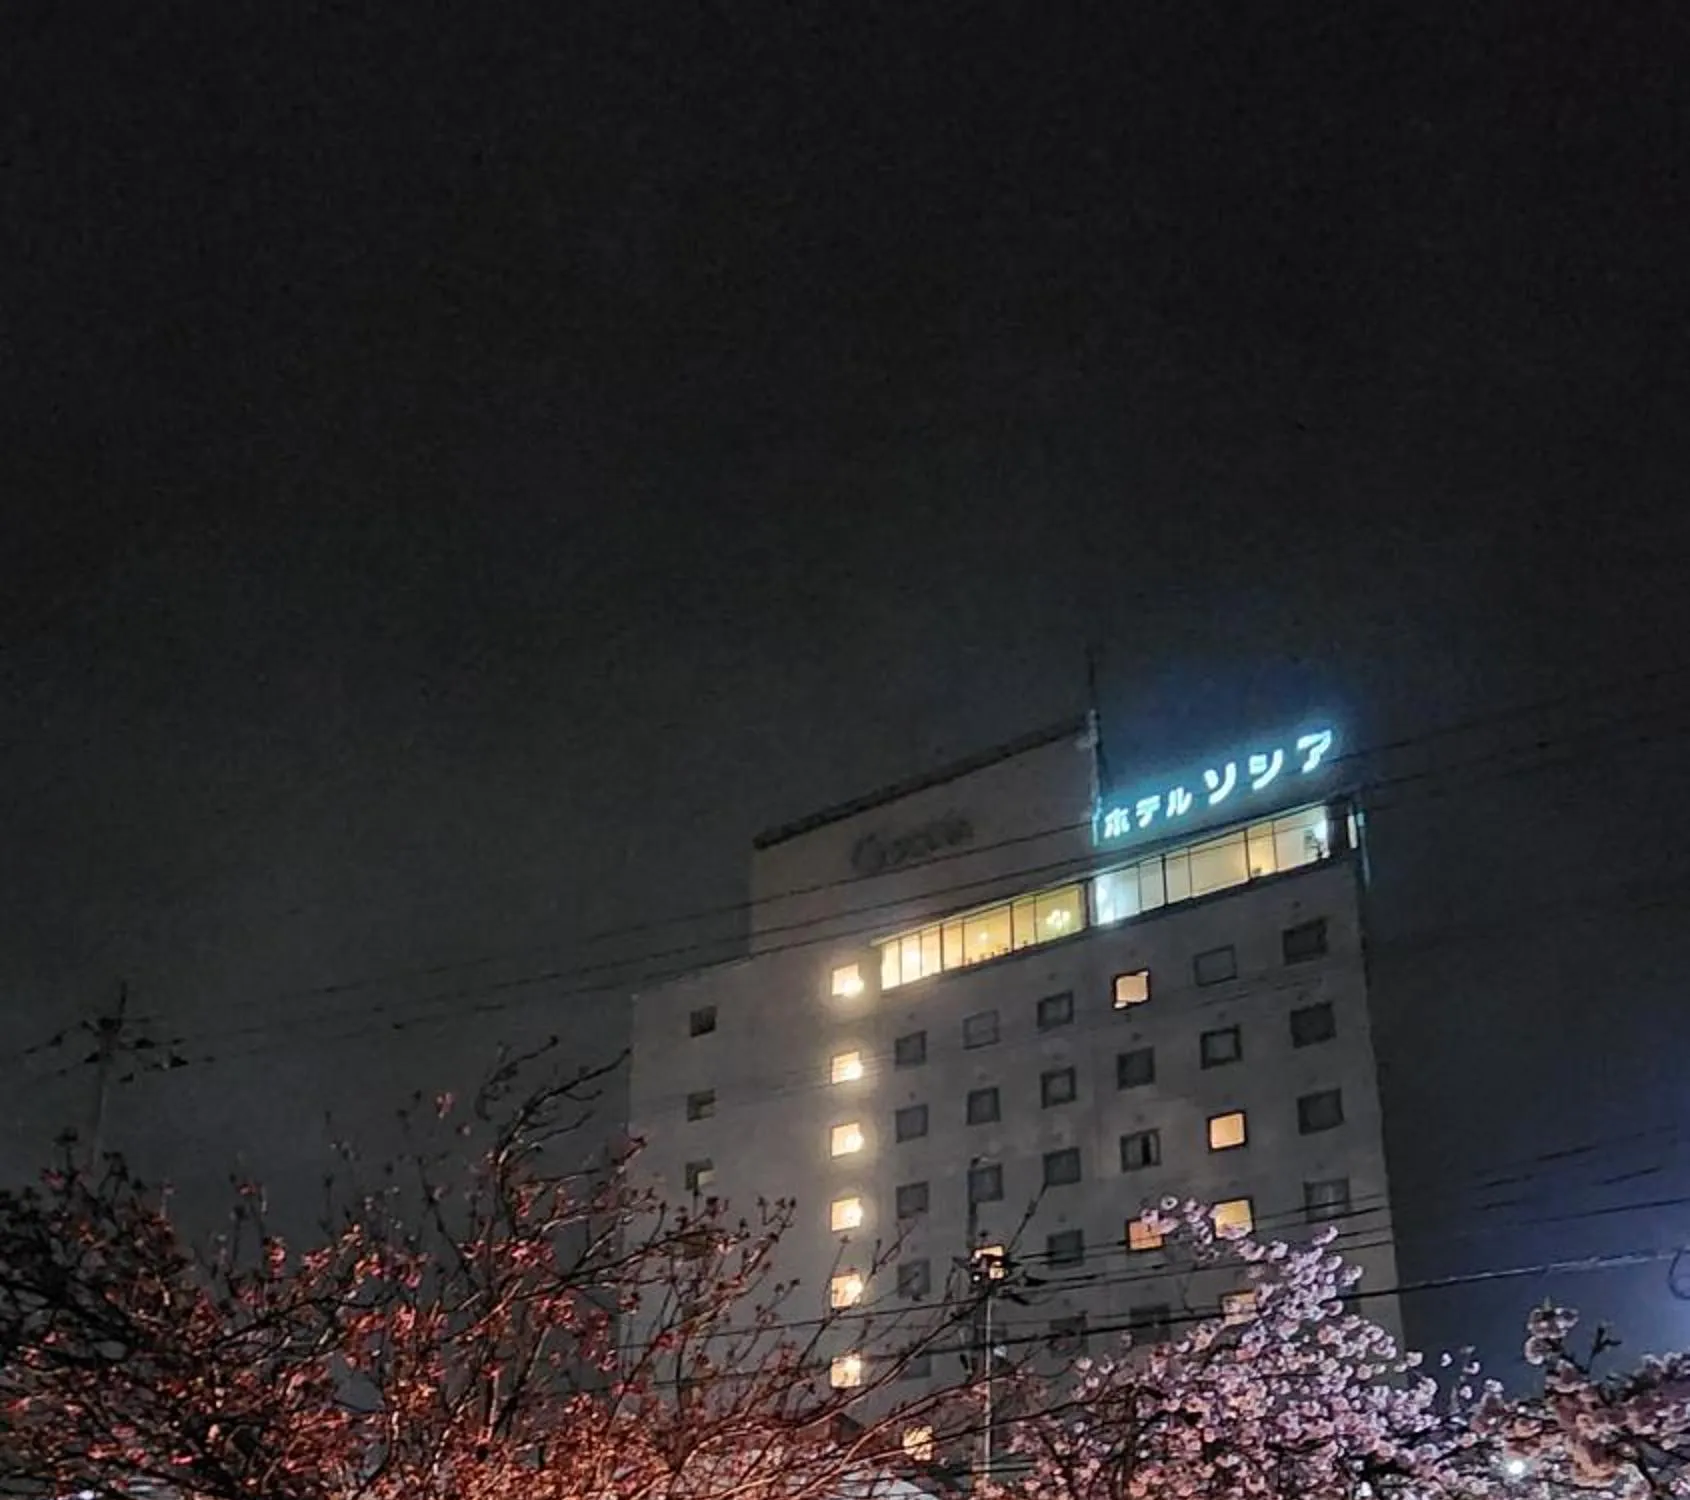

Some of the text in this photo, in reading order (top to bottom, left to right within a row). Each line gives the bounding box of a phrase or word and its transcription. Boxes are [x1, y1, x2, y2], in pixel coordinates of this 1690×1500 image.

[1103, 729, 1333, 839] ホテルソシア
